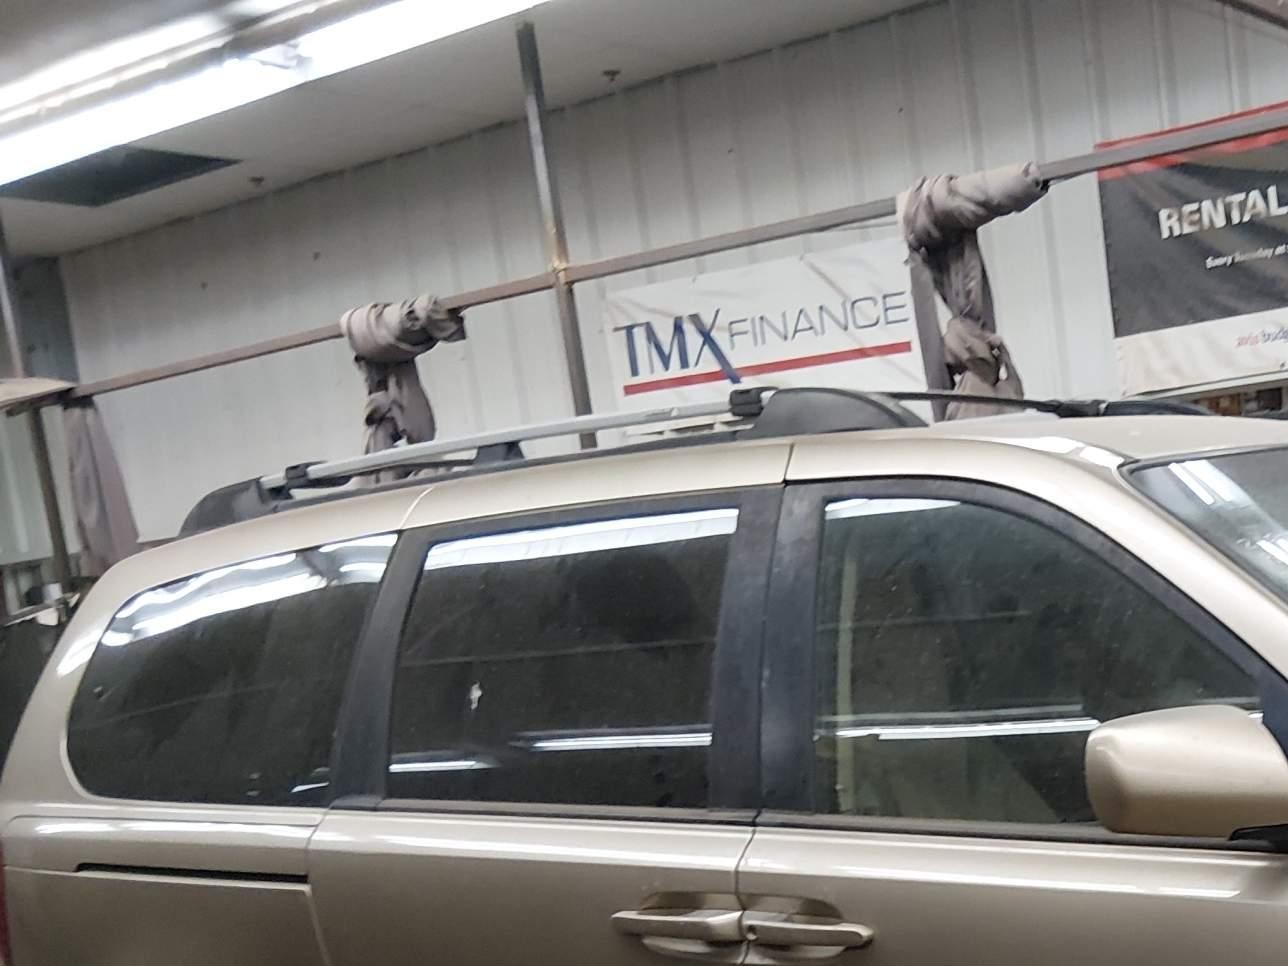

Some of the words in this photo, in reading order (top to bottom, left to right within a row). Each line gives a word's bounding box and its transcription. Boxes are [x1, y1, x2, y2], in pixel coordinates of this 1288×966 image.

[1158, 184, 1288, 240] RENTAL
[613, 309, 743, 384] TMX
[728, 291, 911, 351] FINANCE
